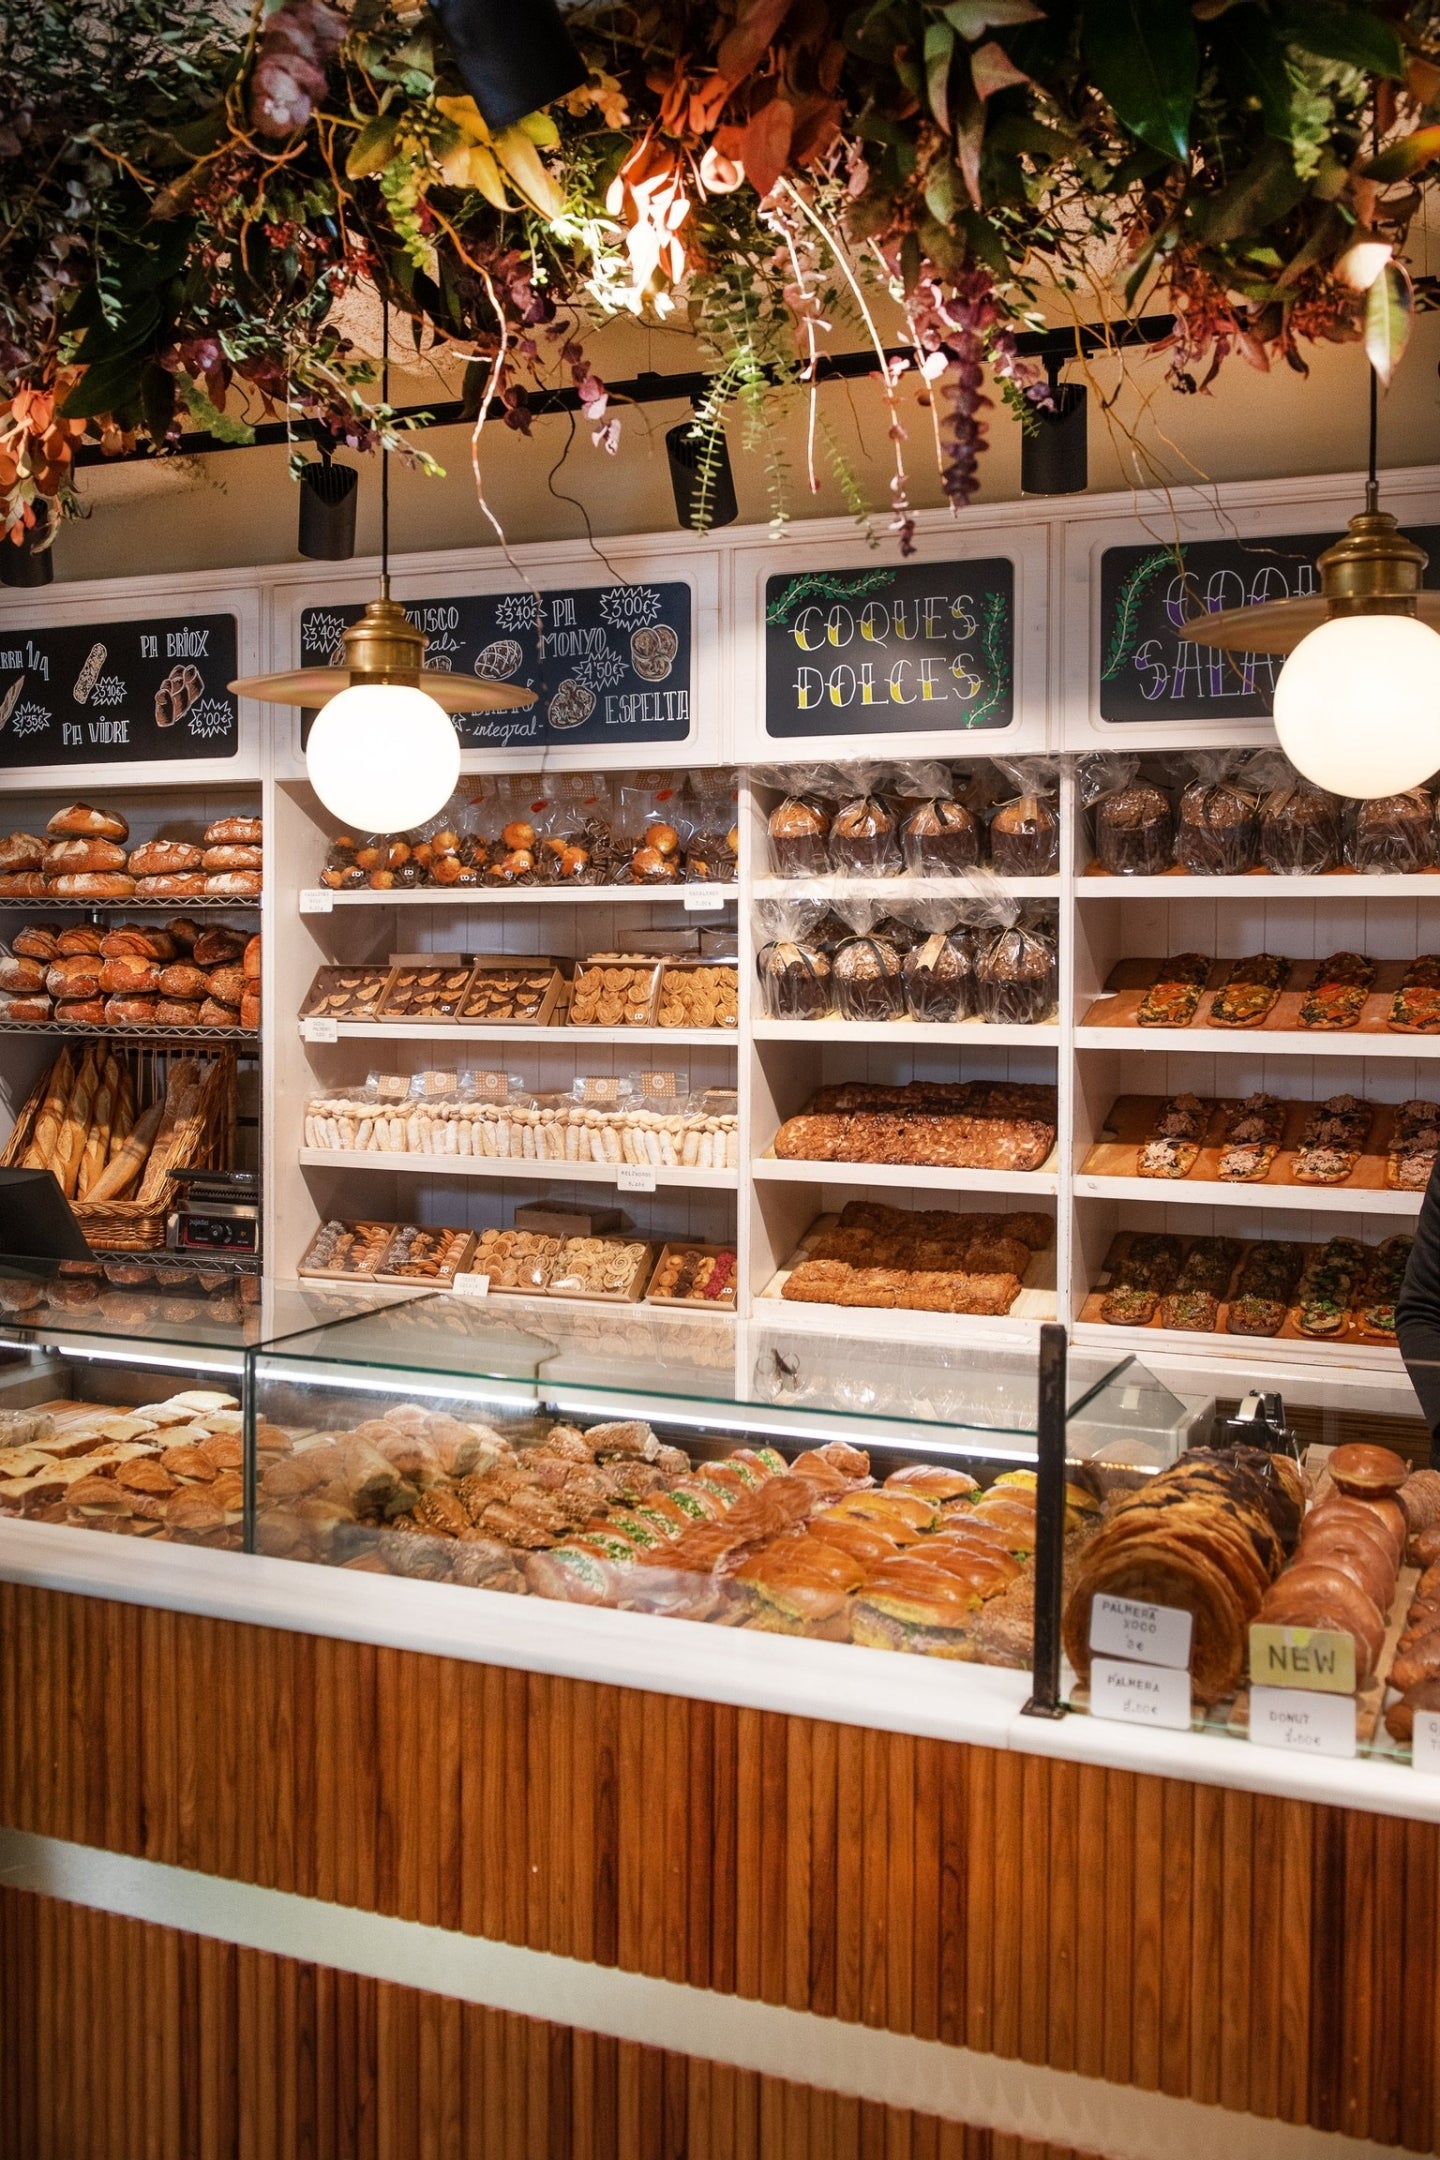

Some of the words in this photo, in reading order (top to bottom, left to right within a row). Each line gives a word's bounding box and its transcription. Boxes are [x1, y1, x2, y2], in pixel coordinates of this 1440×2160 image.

[552, 598, 577, 627] PA
[788, 595, 980, 651] COQUES
[140, 635, 159, 658] PA
[540, 627, 606, 660] MONYO
[792, 653, 985, 710] DOLCES
[604, 690, 690, 724] ESPELTA
[62, 722, 83, 745] PA
[1101, 1600, 1157, 1621] PALMERA
[1268, 1645, 1336, 1675] NEW
